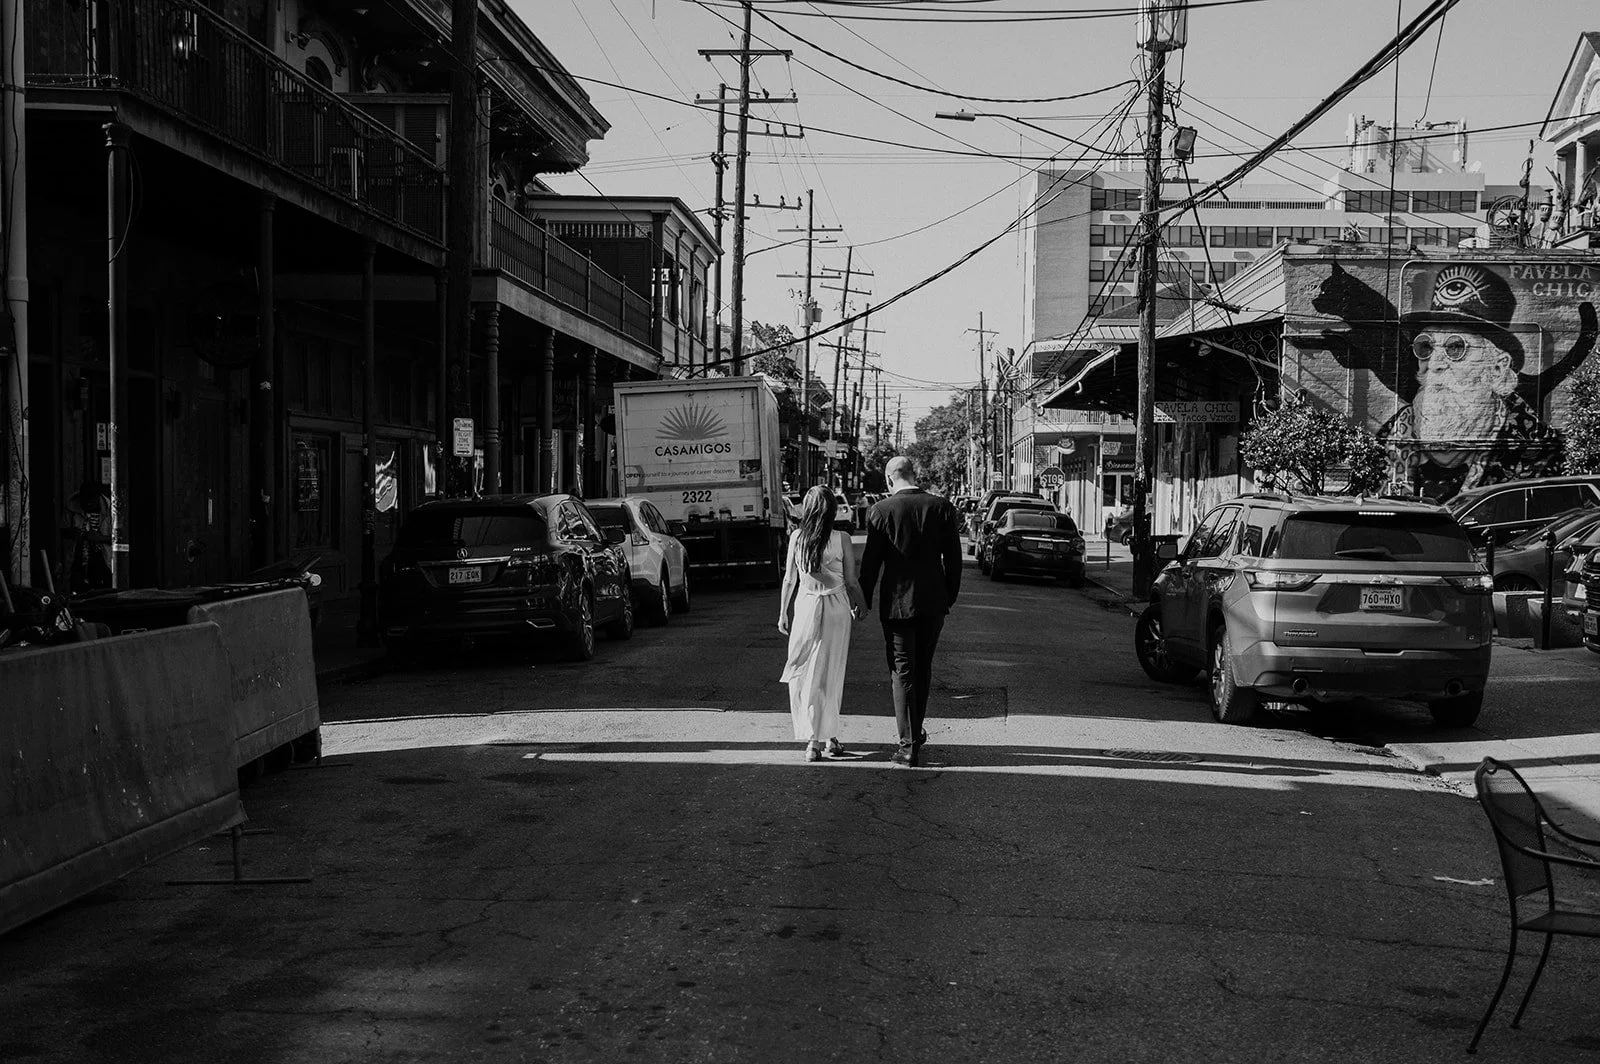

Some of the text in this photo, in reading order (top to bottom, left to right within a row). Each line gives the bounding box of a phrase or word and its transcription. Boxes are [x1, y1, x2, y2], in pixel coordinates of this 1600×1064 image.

[1508, 264, 1591, 280] FAVELA
[1532, 282, 1590, 297] CHIC
[1155, 403, 1233, 413] FAVELA CHIC
[655, 443, 731, 457] CASAMIGOS
[1041, 474, 1064, 484] STOP
[682, 490, 712, 504] 2322
[450, 571, 463, 580] 217
[1363, 593, 1379, 604] 760
